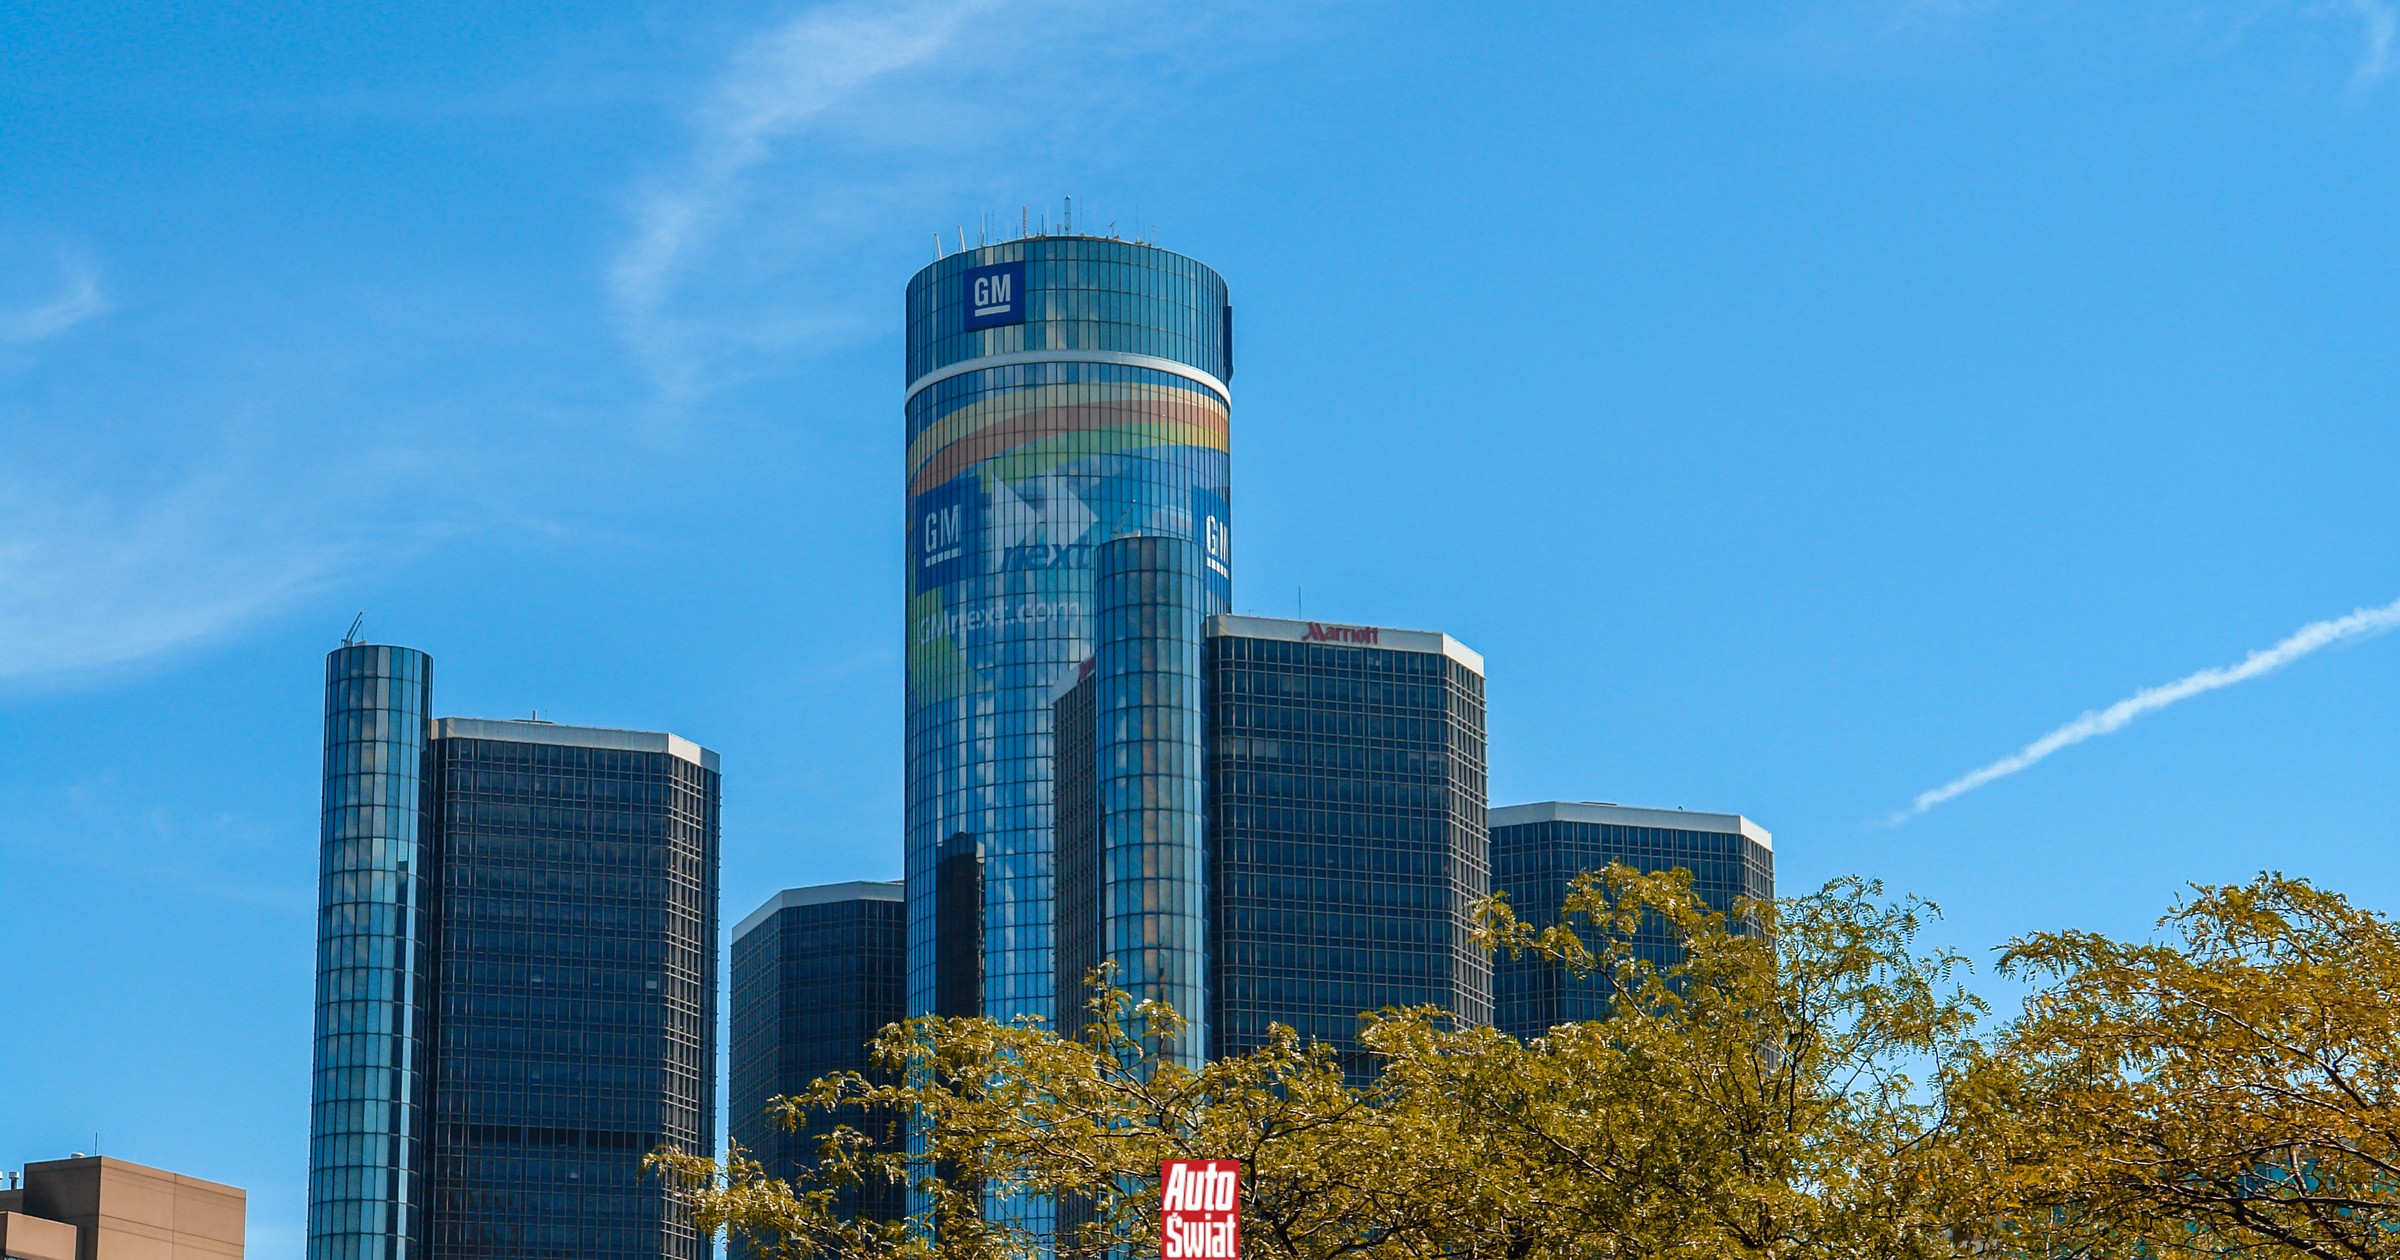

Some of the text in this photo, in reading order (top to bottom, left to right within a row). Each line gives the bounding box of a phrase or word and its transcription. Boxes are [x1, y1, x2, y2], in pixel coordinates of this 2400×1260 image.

[975, 274, 1011, 307] GM
[925, 504, 961, 553] GM
[1205, 515, 1229, 563] GM
[1000, 542, 1090, 573] next
[1302, 621, 1379, 645] Marriott
